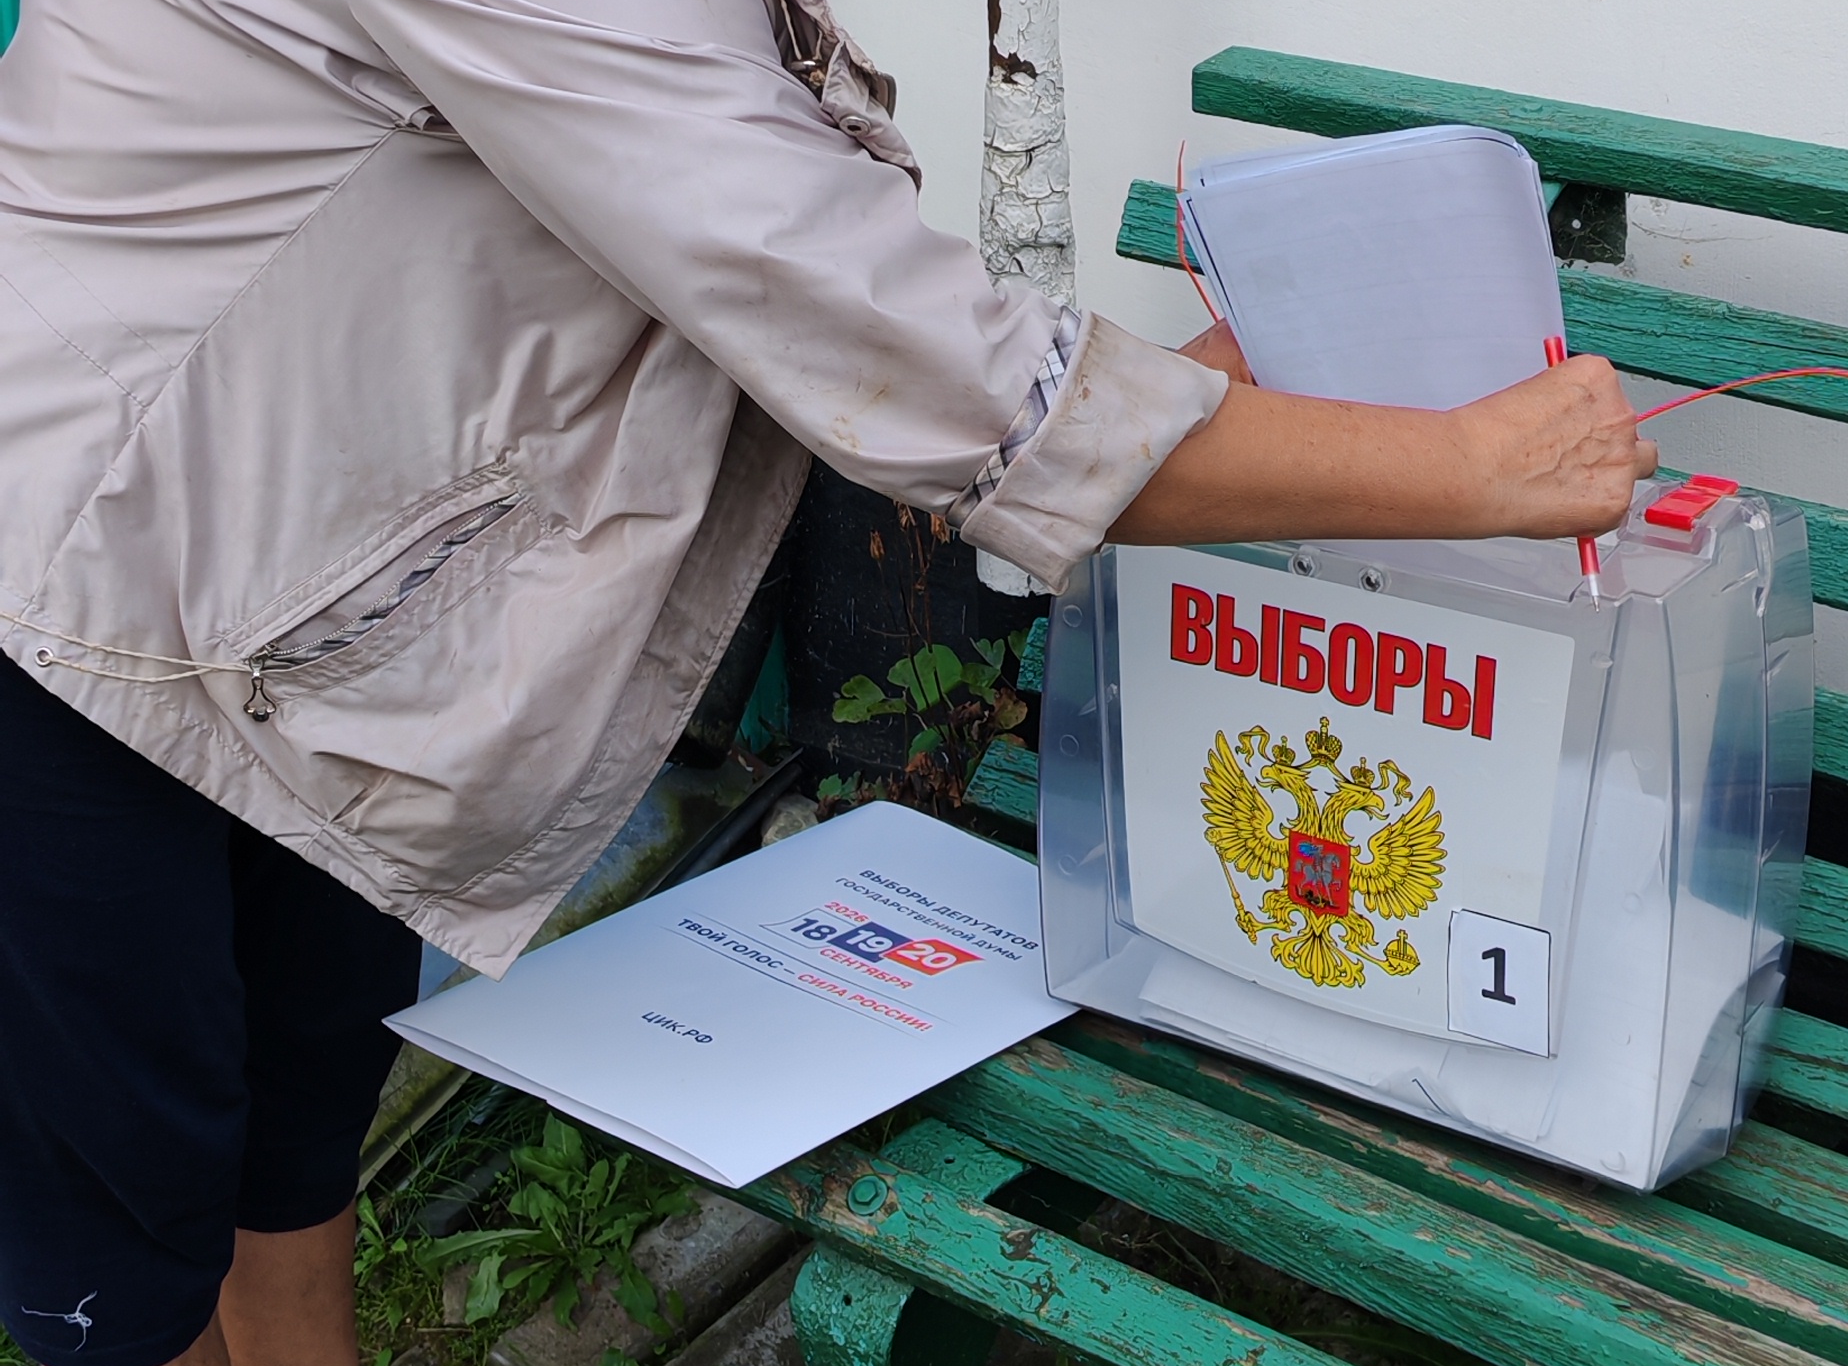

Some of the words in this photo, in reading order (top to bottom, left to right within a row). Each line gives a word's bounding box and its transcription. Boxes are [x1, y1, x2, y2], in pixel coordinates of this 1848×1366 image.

[1170, 583, 1497, 740] ВЫБОРЫ
[824, 901, 869, 923] 2026
[835, 878, 977, 945] ГОСУДАРСТВЕННОЙ
[974, 937, 1023, 961] ДУМЫ
[859, 870, 936, 908] ВЫБОРЫ
[933, 906, 1039, 951] ДЕПУТАТОВ
[790, 918, 837, 940] 18
[846, 928, 894, 953] 19
[897, 943, 957, 969] 20
[820, 948, 913, 990] СЕНТЯБРЯ
[677, 918, 727, 944] ТВОЙ
[723, 939, 784, 969] ГОЛОС
[797, 973, 848, 998] СИЛА
[848, 993, 932, 1032] РОССИИ!
[1480, 947, 1517, 1006] 1
[641, 1011, 713, 1043] ЦИК.РФ
